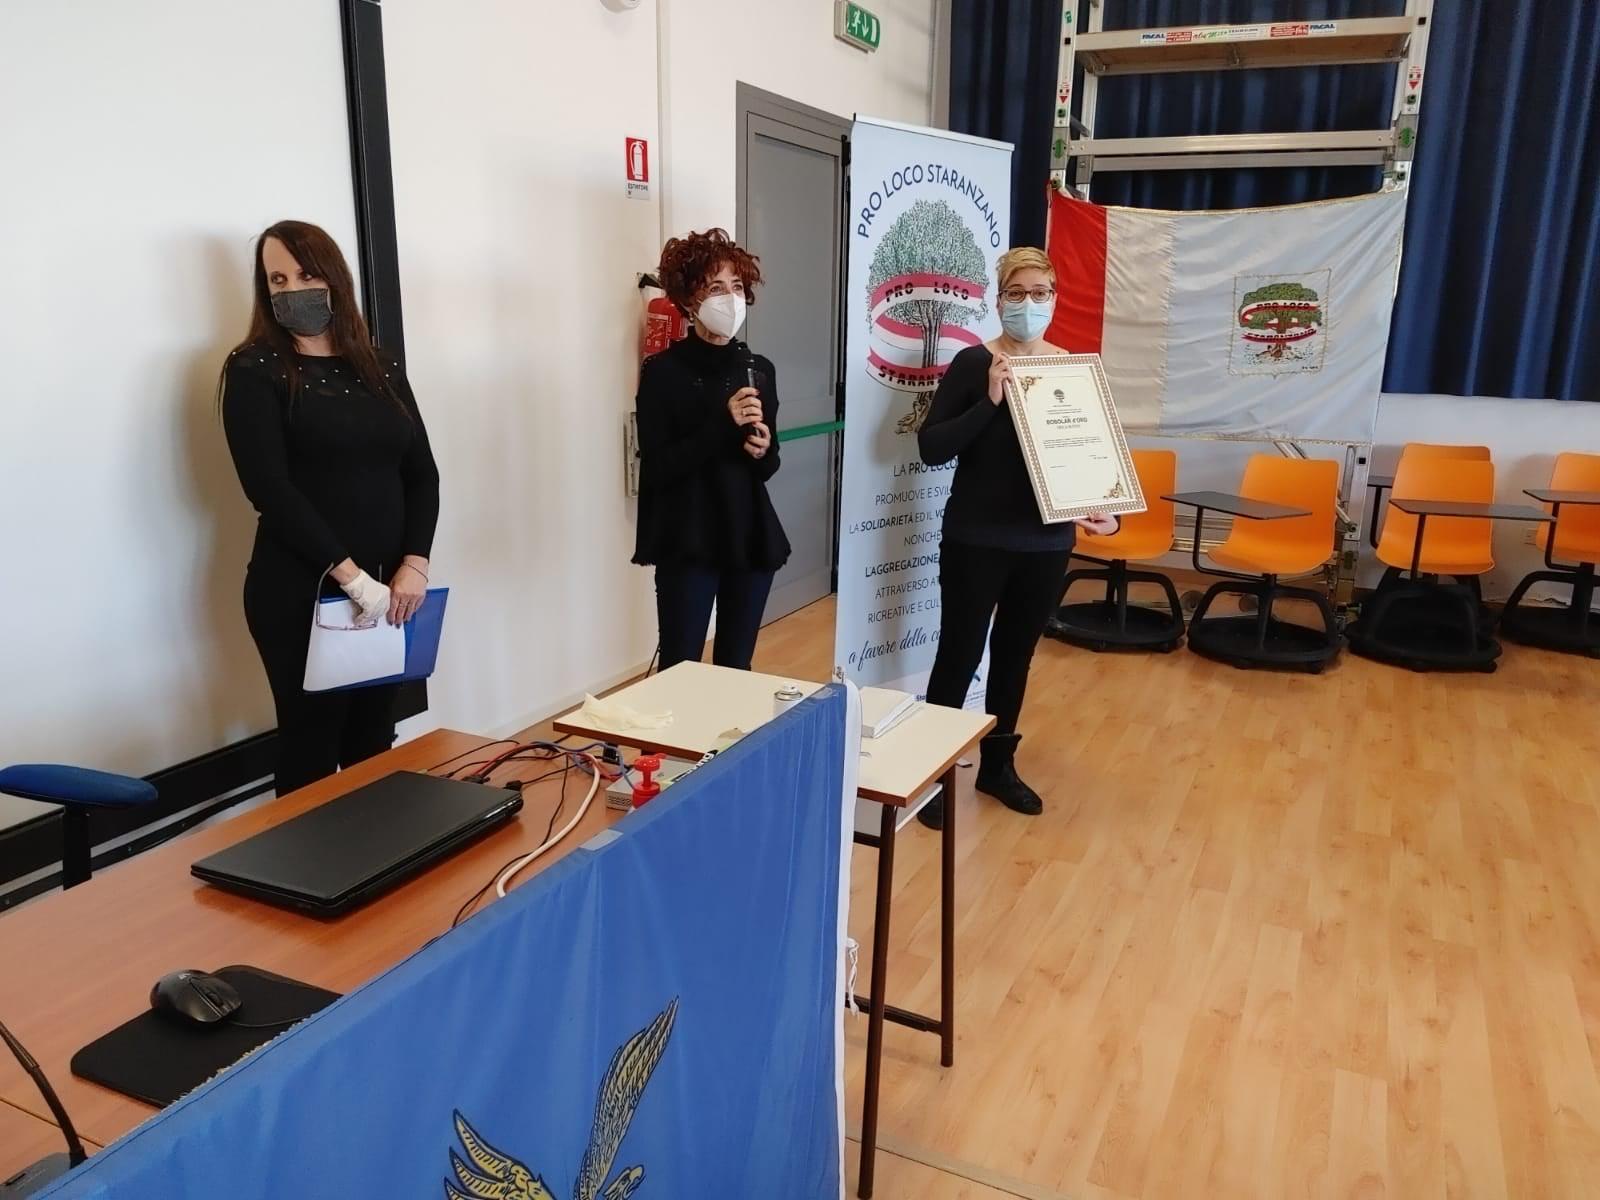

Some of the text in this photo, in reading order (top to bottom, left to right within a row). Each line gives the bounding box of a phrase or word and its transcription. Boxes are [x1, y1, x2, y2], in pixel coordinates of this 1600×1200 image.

[857, 164, 1001, 248] PRO LOCO STARANZANO
[885, 281, 969, 302] PRO LOCO
[894, 465, 906, 477] LA
[908, 462, 928, 474] PRO
[875, 488, 925, 506] PROMUOVE
[927, 488, 932, 498] E
[849, 523, 859, 534] LA
[915, 511, 925, 523] ED
[875, 577, 928, 599] ATTRAVERSO
[867, 603, 915, 623] RICREATIVE
[917, 601, 922, 612] E
[849, 651, 855, 664] a
[857, 640, 896, 671] favore
[900, 627, 926, 650] della
